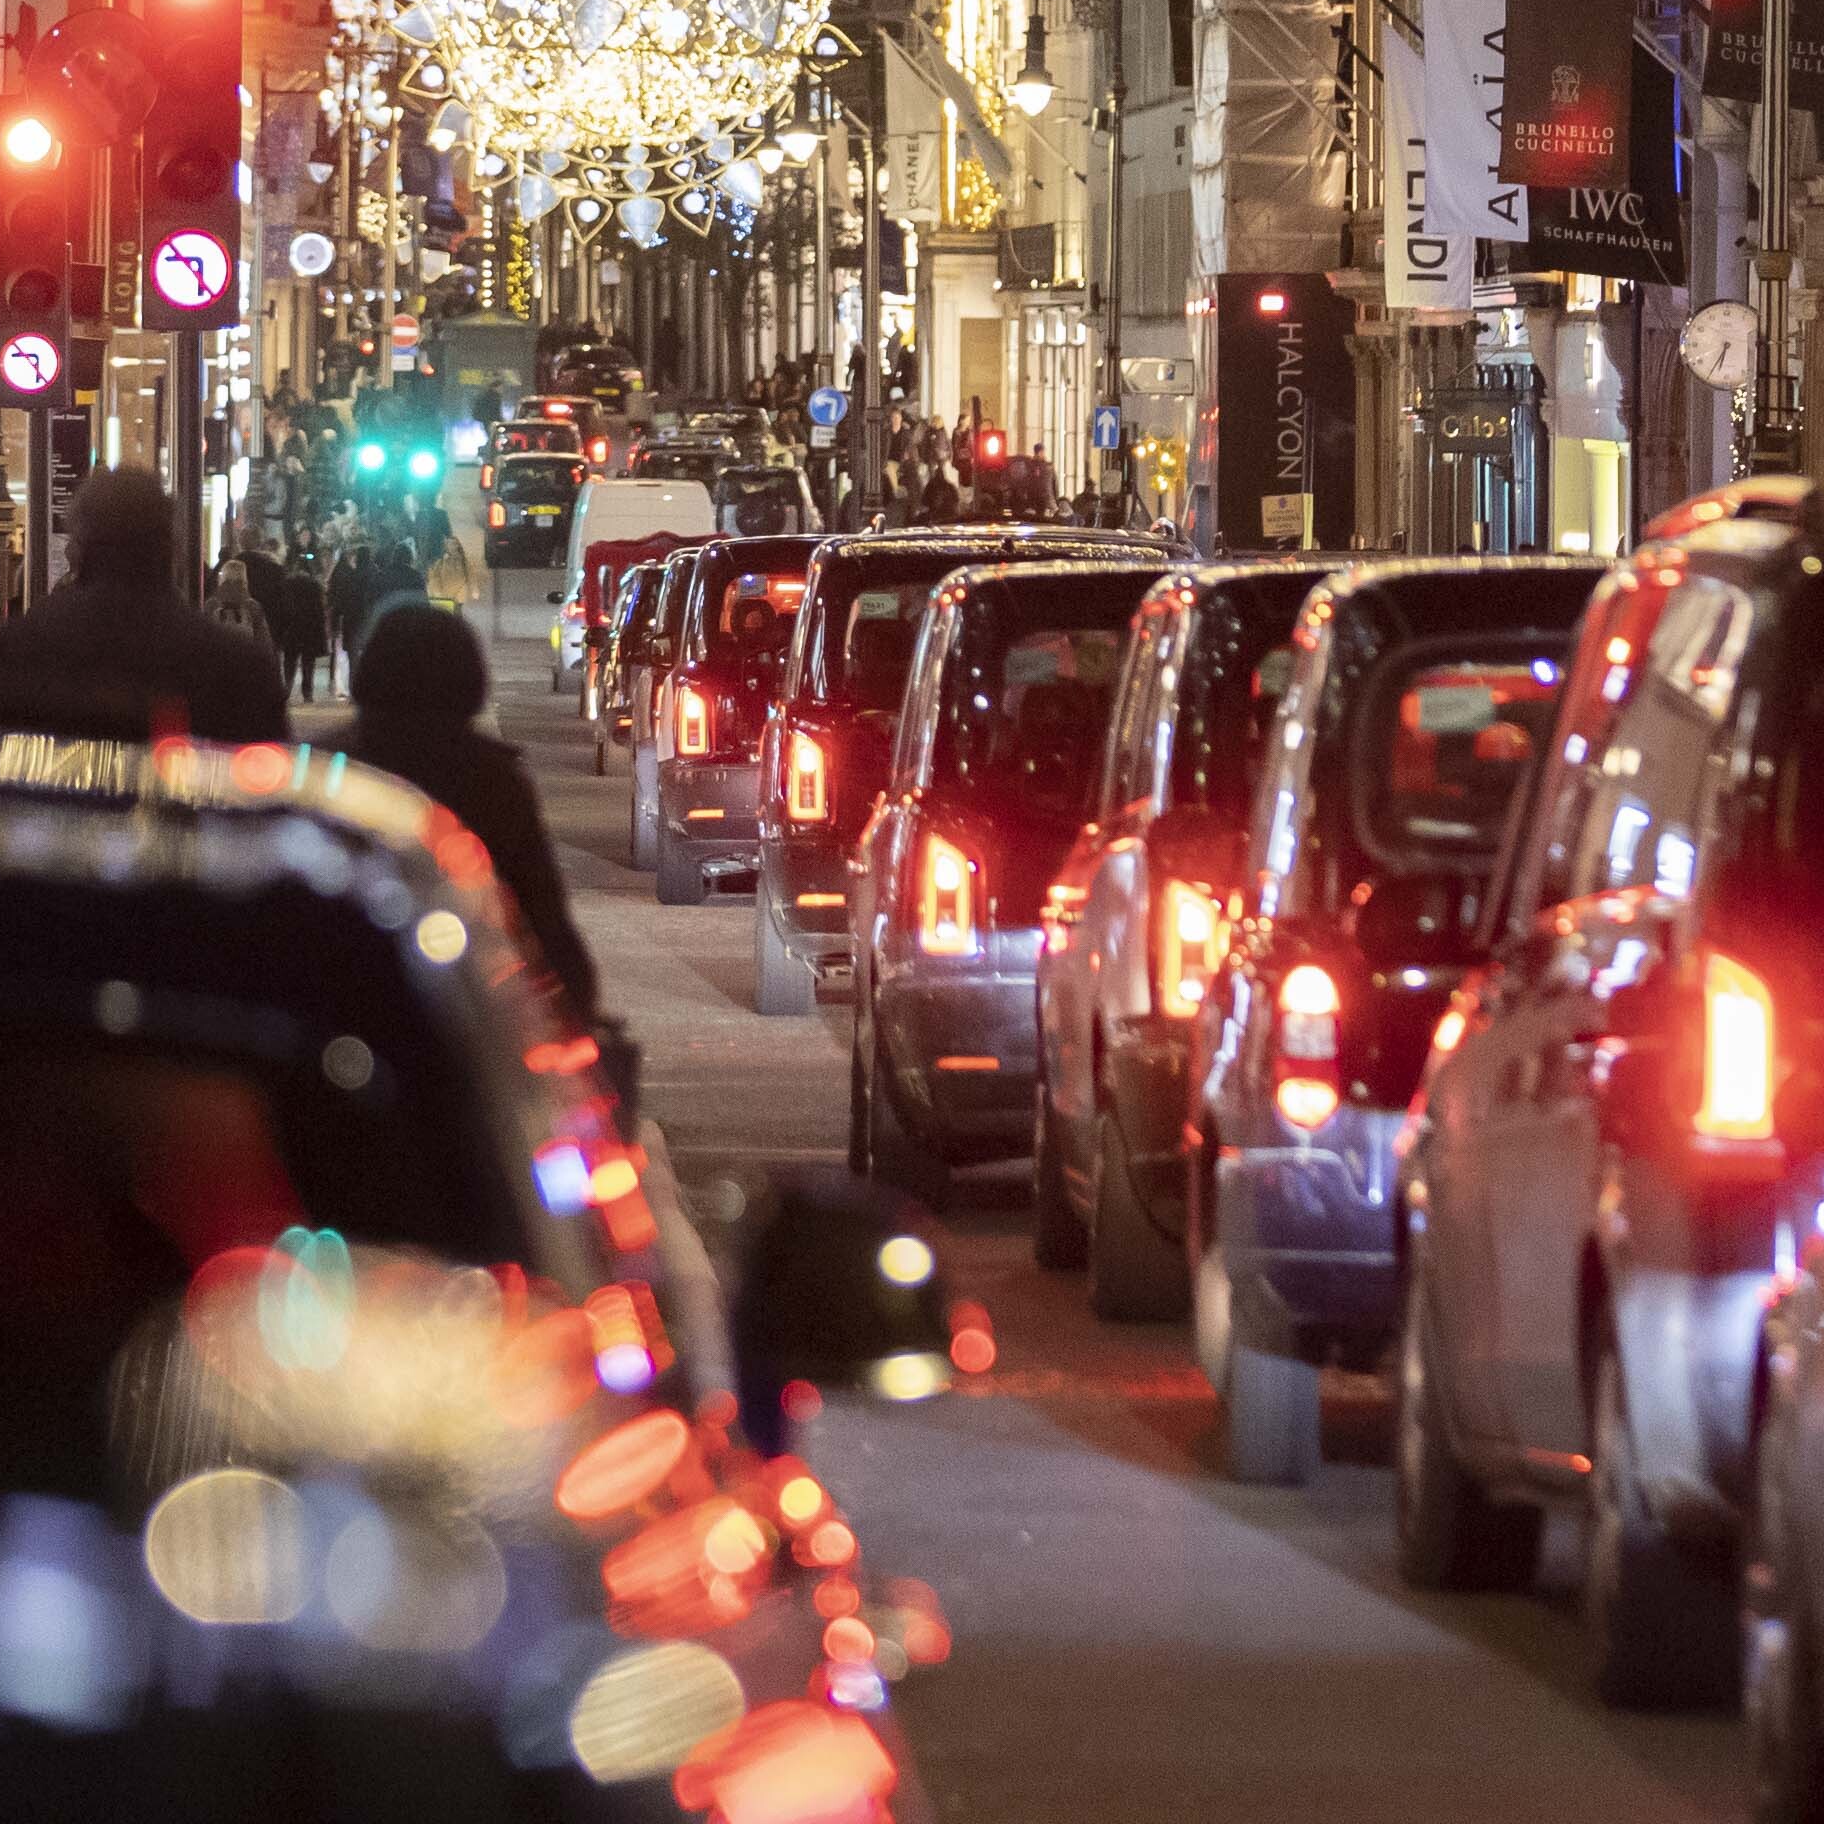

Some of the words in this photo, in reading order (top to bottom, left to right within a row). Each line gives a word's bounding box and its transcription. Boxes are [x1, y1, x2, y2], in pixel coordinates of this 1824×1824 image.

[1516, 122, 1614, 139] BRUNELLO
[1515, 138, 1615, 155] CUCINELLI
[1569, 187, 1645, 226] IWC
[1543, 226, 1673, 252] SCHAFFHAUSEN
[1277, 322, 1304, 478] HALCYON
